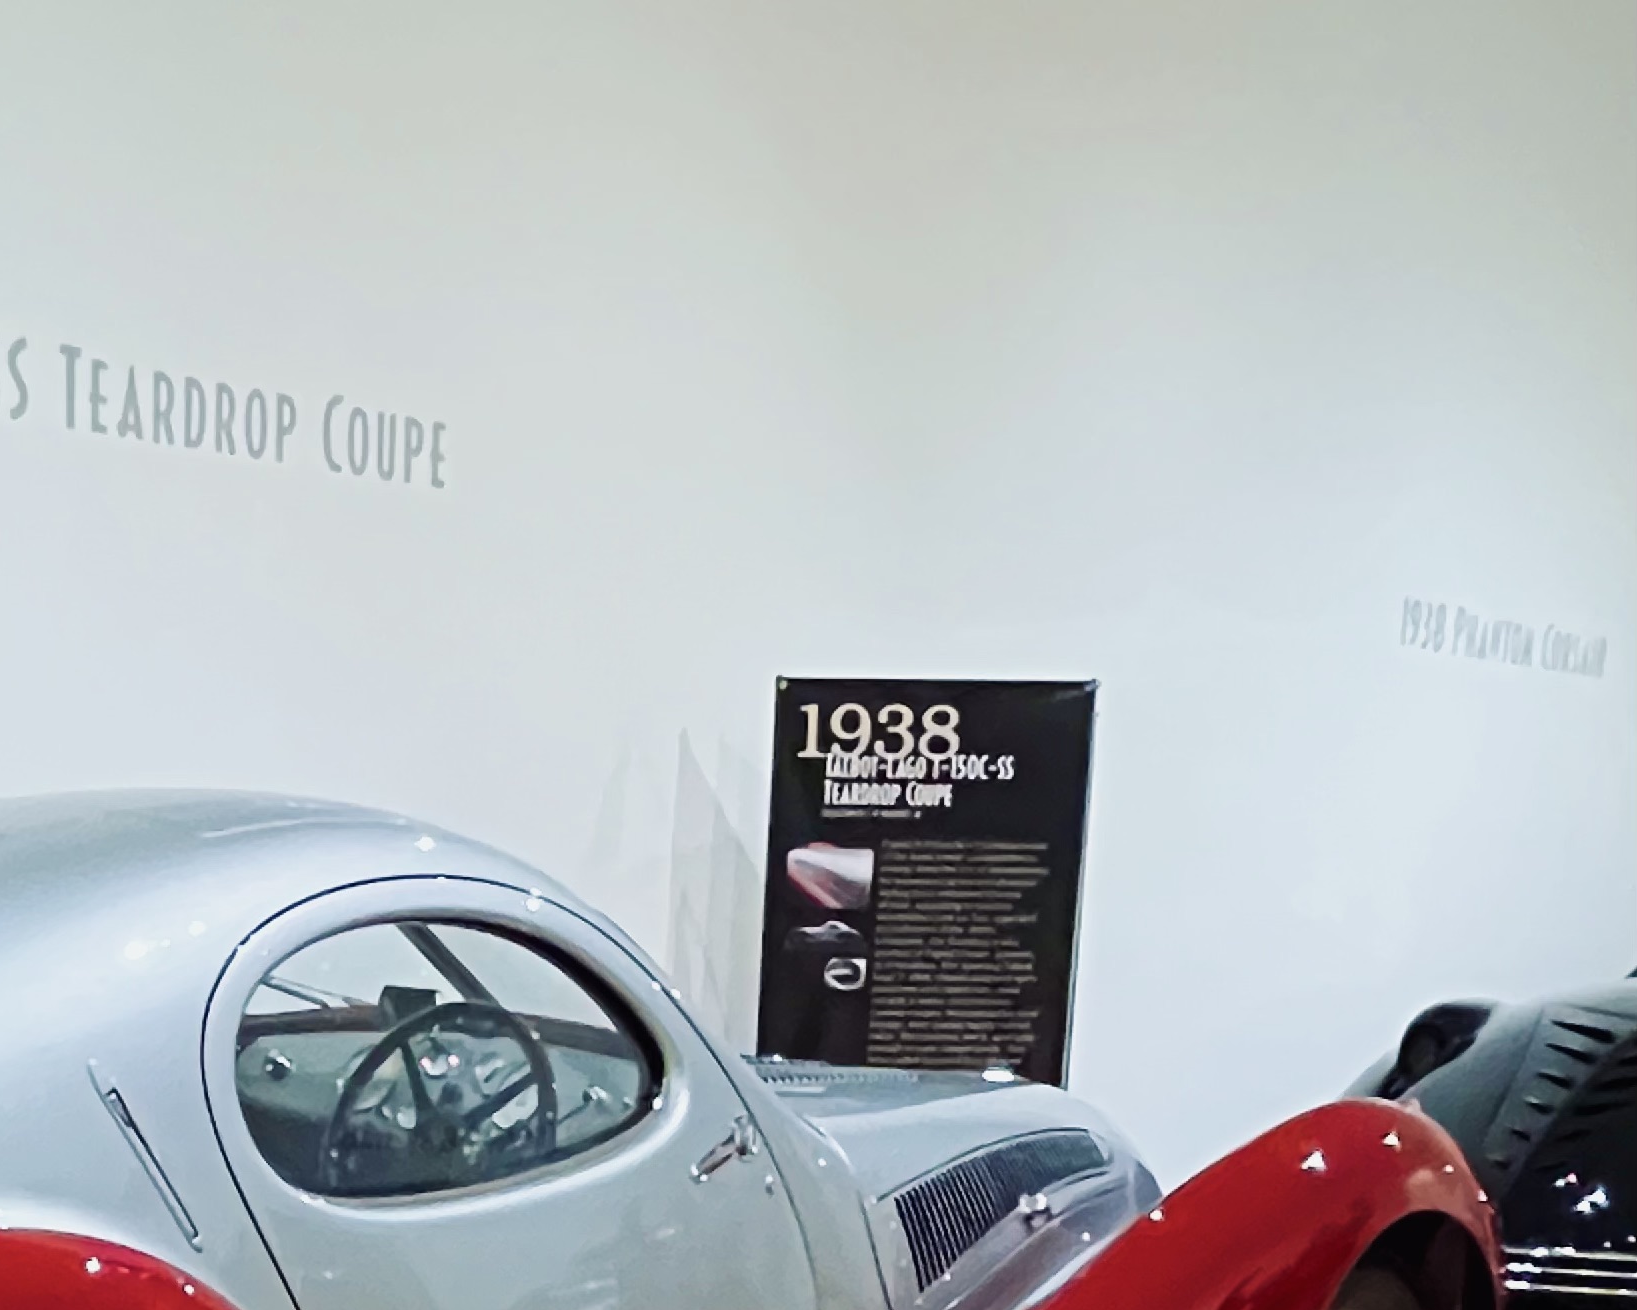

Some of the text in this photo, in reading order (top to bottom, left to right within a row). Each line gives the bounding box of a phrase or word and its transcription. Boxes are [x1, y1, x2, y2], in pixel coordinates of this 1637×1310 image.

[58, 343, 297, 464] TEARDROP
[322, 394, 448, 490] COUPE
[1399, 595, 1447, 654] 1938
[797, 702, 961, 761] 1938
